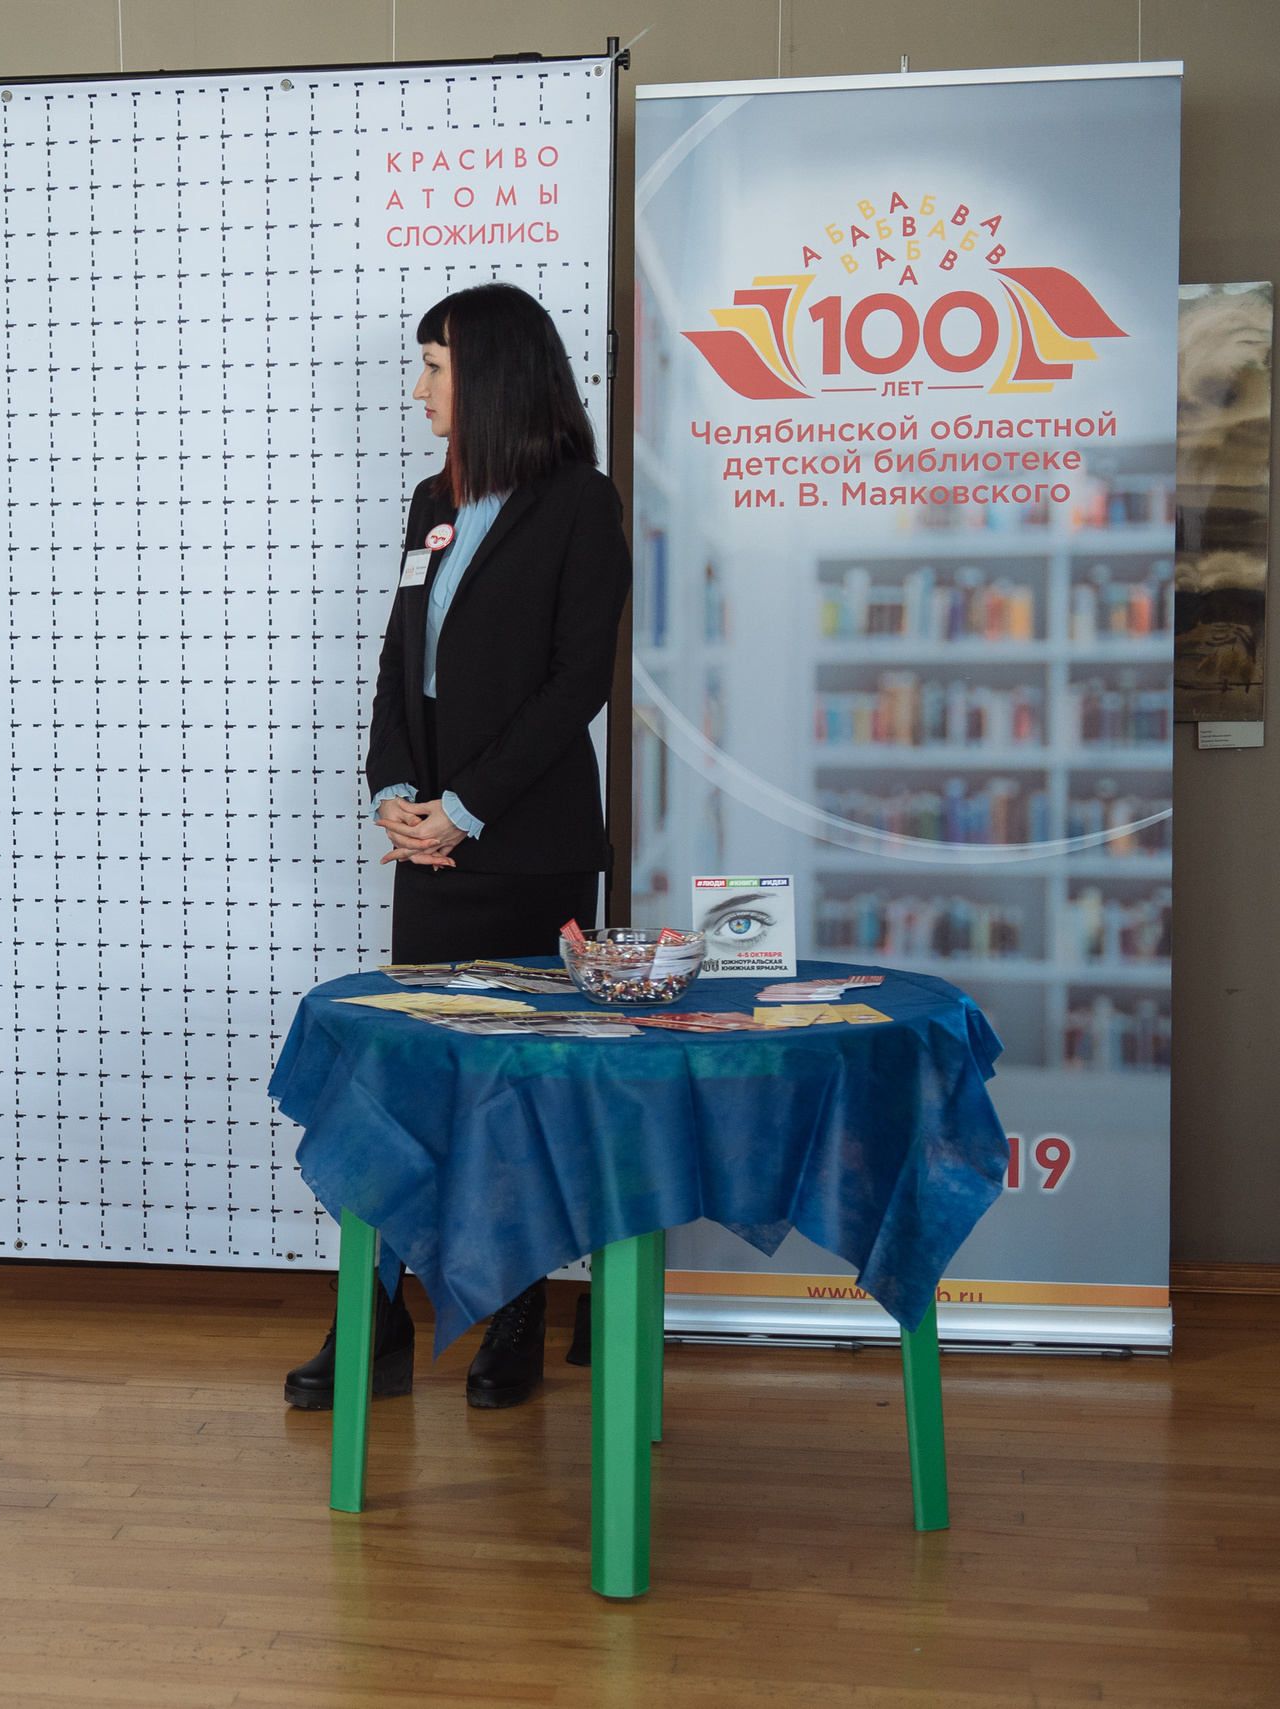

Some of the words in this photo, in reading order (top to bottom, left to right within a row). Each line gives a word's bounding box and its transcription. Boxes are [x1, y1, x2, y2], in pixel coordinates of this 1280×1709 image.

[387, 146, 559, 173] КРАСИВО
[386, 184, 558, 210] АТОМЫ
[386, 222, 559, 248] СЛОЖИЛИСЬ
[808, 290, 1000, 375] 100
[881, 381, 924, 397] ЛЕТ
[690, 415, 918, 446] Челябинской
[930, 410, 1117, 440] областной
[723, 449, 861, 480] детской
[874, 447, 1081, 476] библиотеке
[734, 488, 785, 508] им.
[798, 483, 828, 507] В.
[842, 482, 1071, 507] Маяковского
